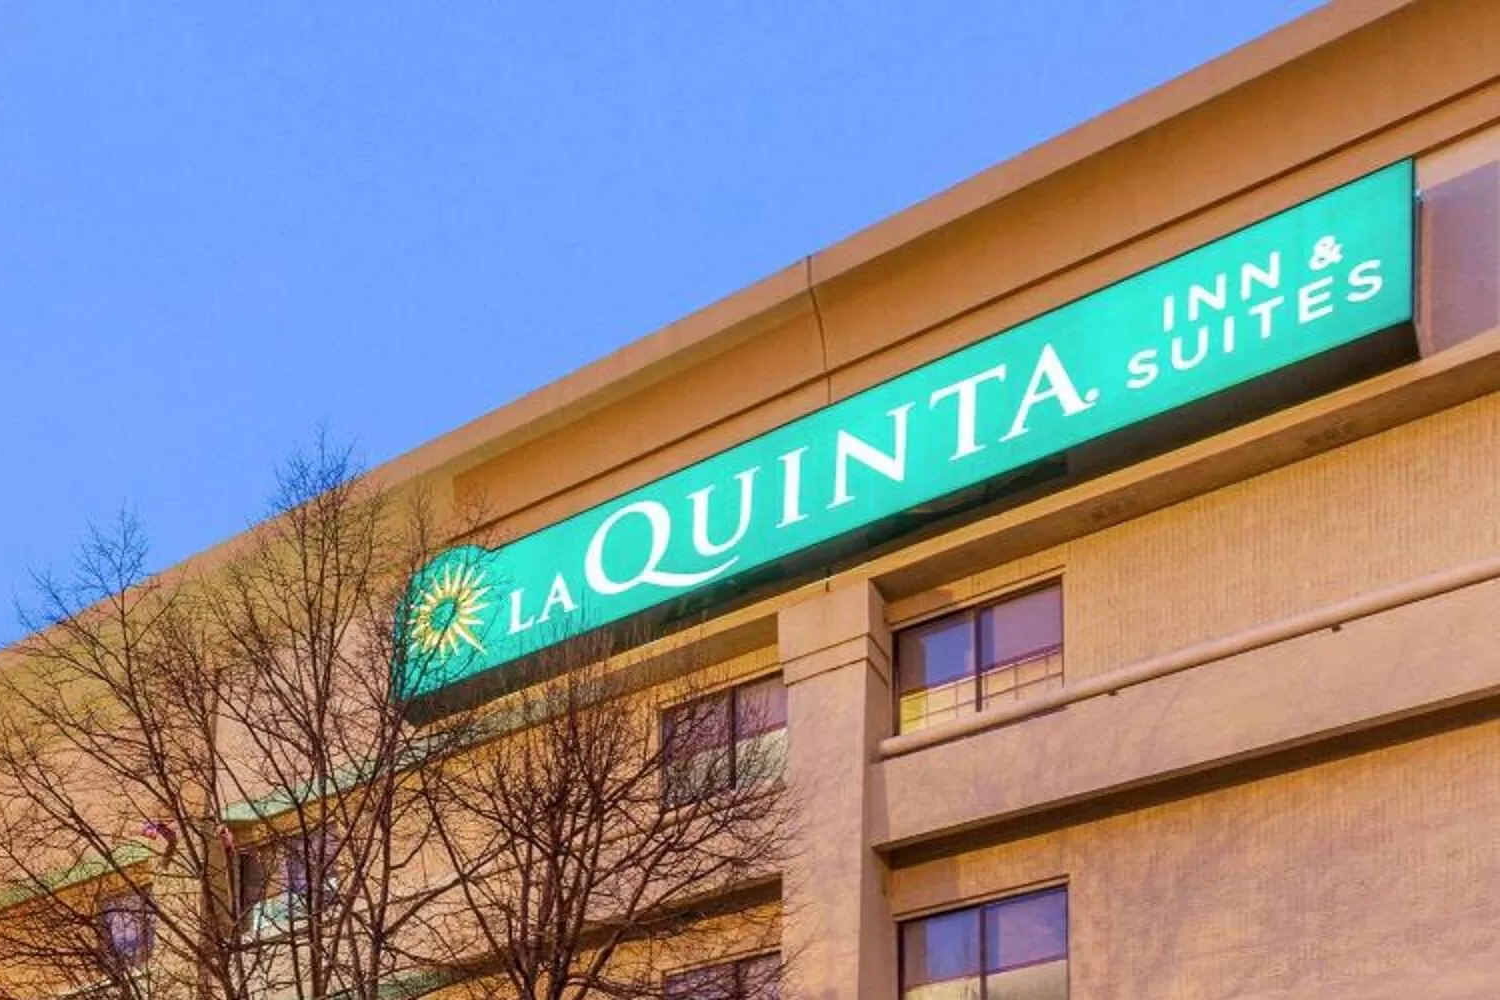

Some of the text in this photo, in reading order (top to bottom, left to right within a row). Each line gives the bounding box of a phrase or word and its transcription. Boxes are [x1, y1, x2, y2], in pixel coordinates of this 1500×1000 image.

[1126, 259, 1384, 389] SUITES
[1162, 235, 1344, 332] INN &
[508, 343, 1097, 636] LA QUINTA
